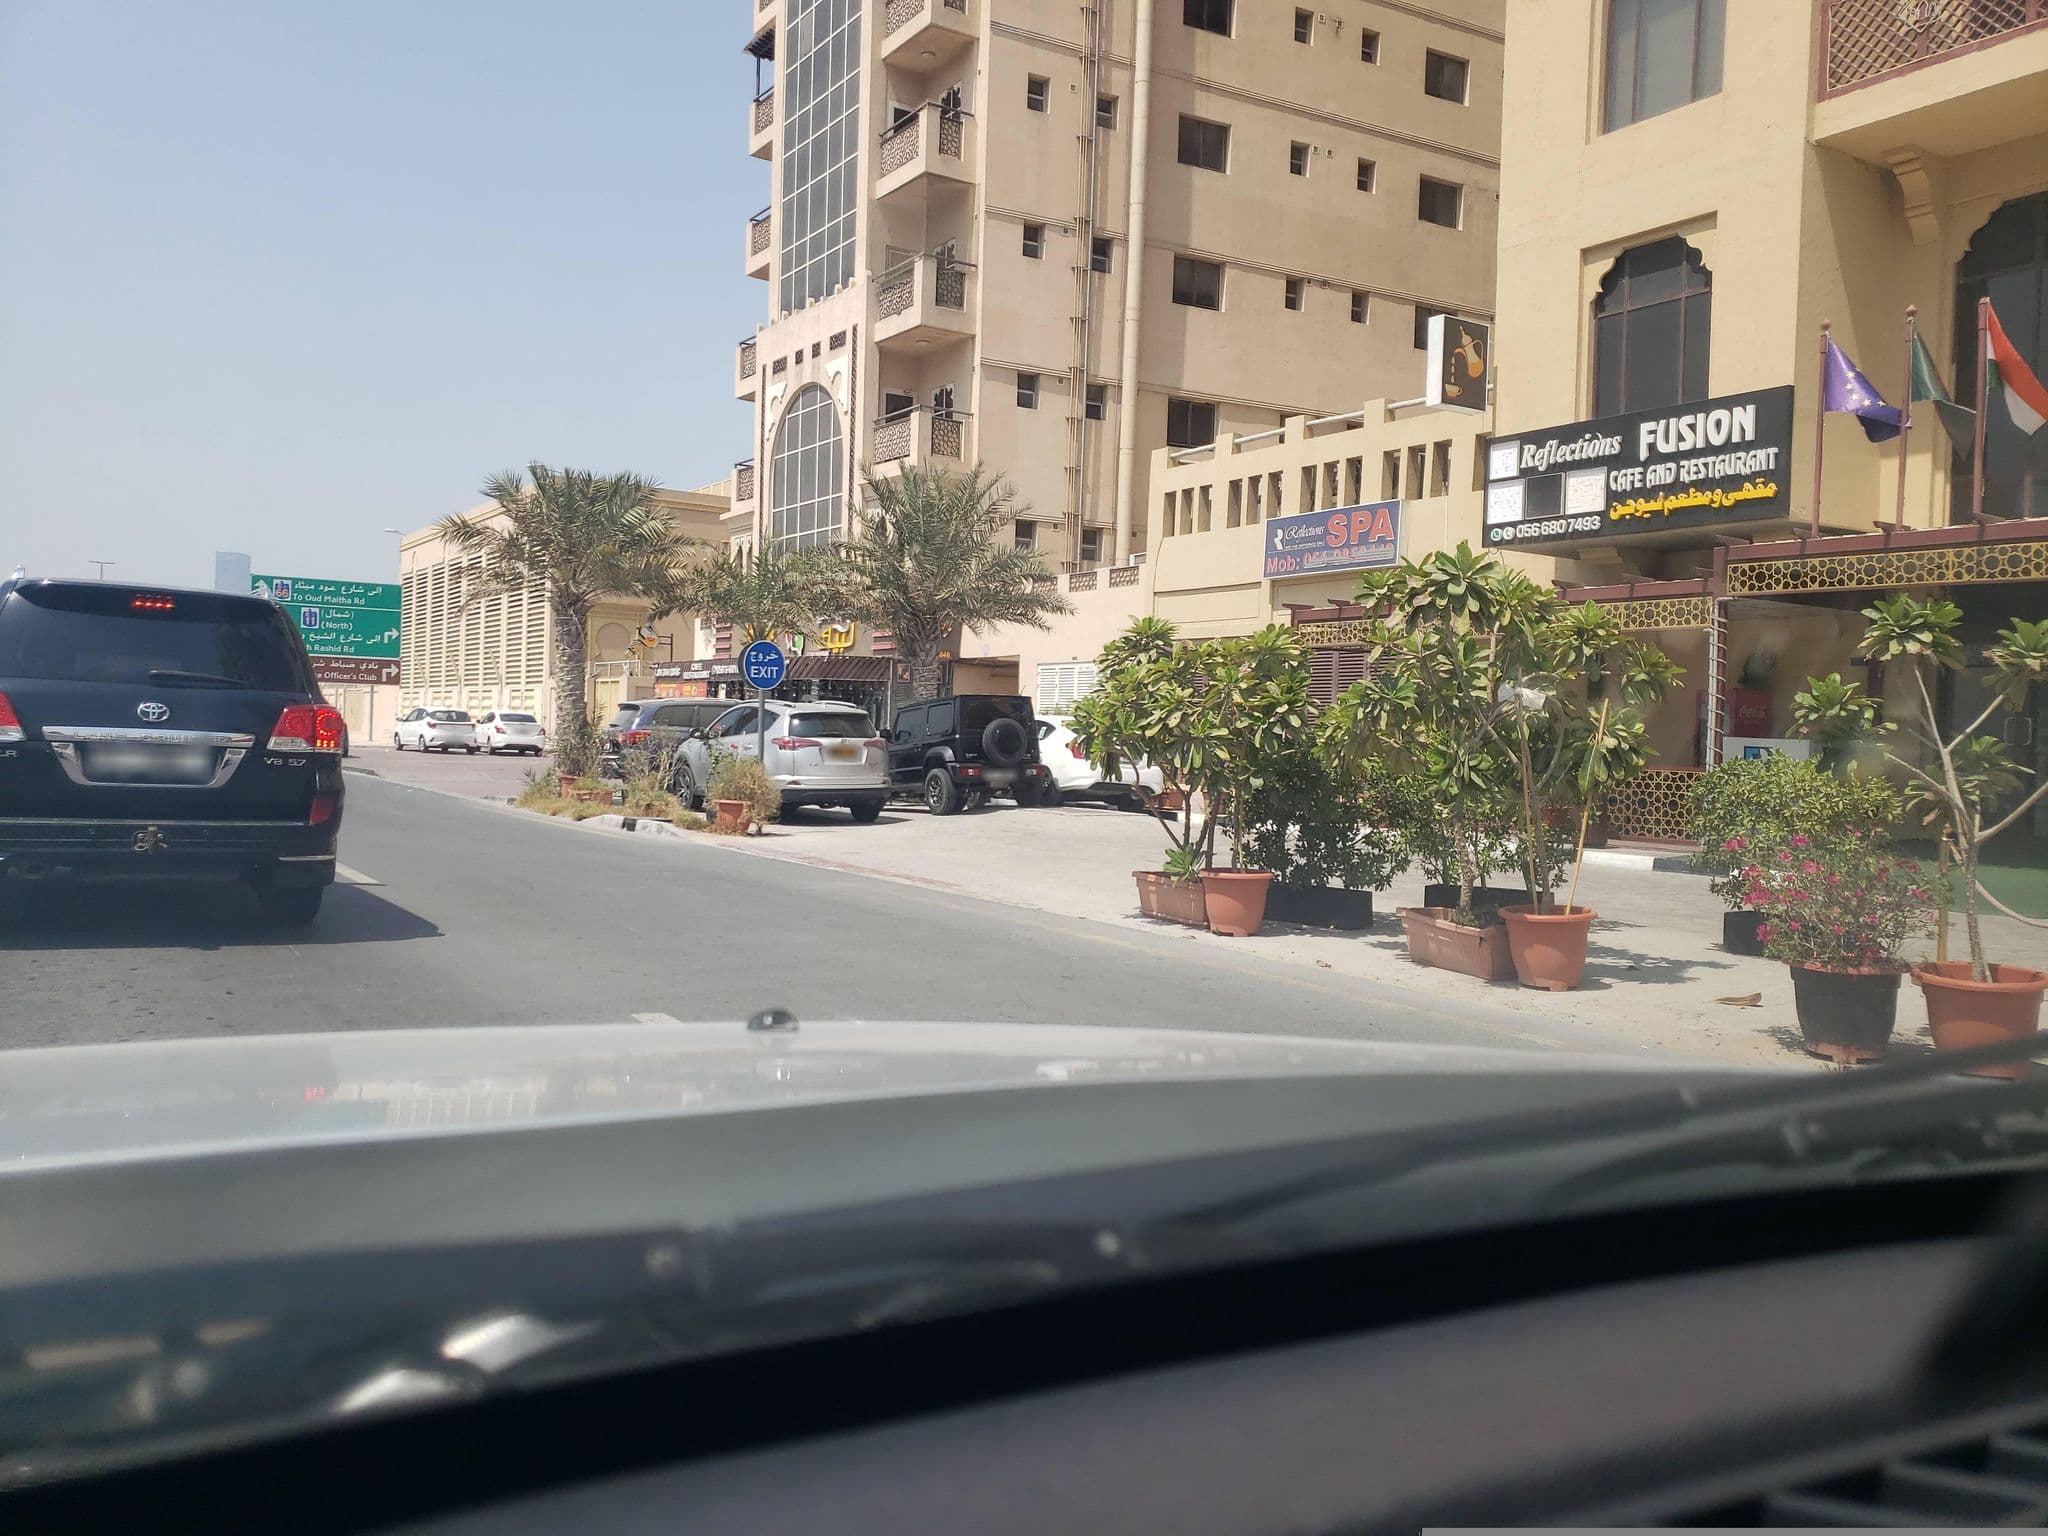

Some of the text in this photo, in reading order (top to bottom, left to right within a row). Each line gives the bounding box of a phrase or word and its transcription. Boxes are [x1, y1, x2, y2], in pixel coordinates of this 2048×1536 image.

[1639, 404, 1757, 463] FUSION
[1520, 431, 1622, 472] Reflections
[1609, 447, 1779, 492] CAFE AND RESTAURANT
[1326, 507, 1395, 548] SPA
[1516, 515, 1602, 538] 056 680 7493
[1265, 557, 1300, 574] Mob:
[293, 593, 365, 605] To Oud Maitha Rd
[321, 621, 353, 631] (North)
[314, 643, 342, 652] Rashid
[343, 645, 355, 653] Rd
[750, 650, 779, 663] خروج
[323, 671, 357, 681] Officer's
[358, 673, 377, 681] Club
[750, 666, 779, 679] EXIT
